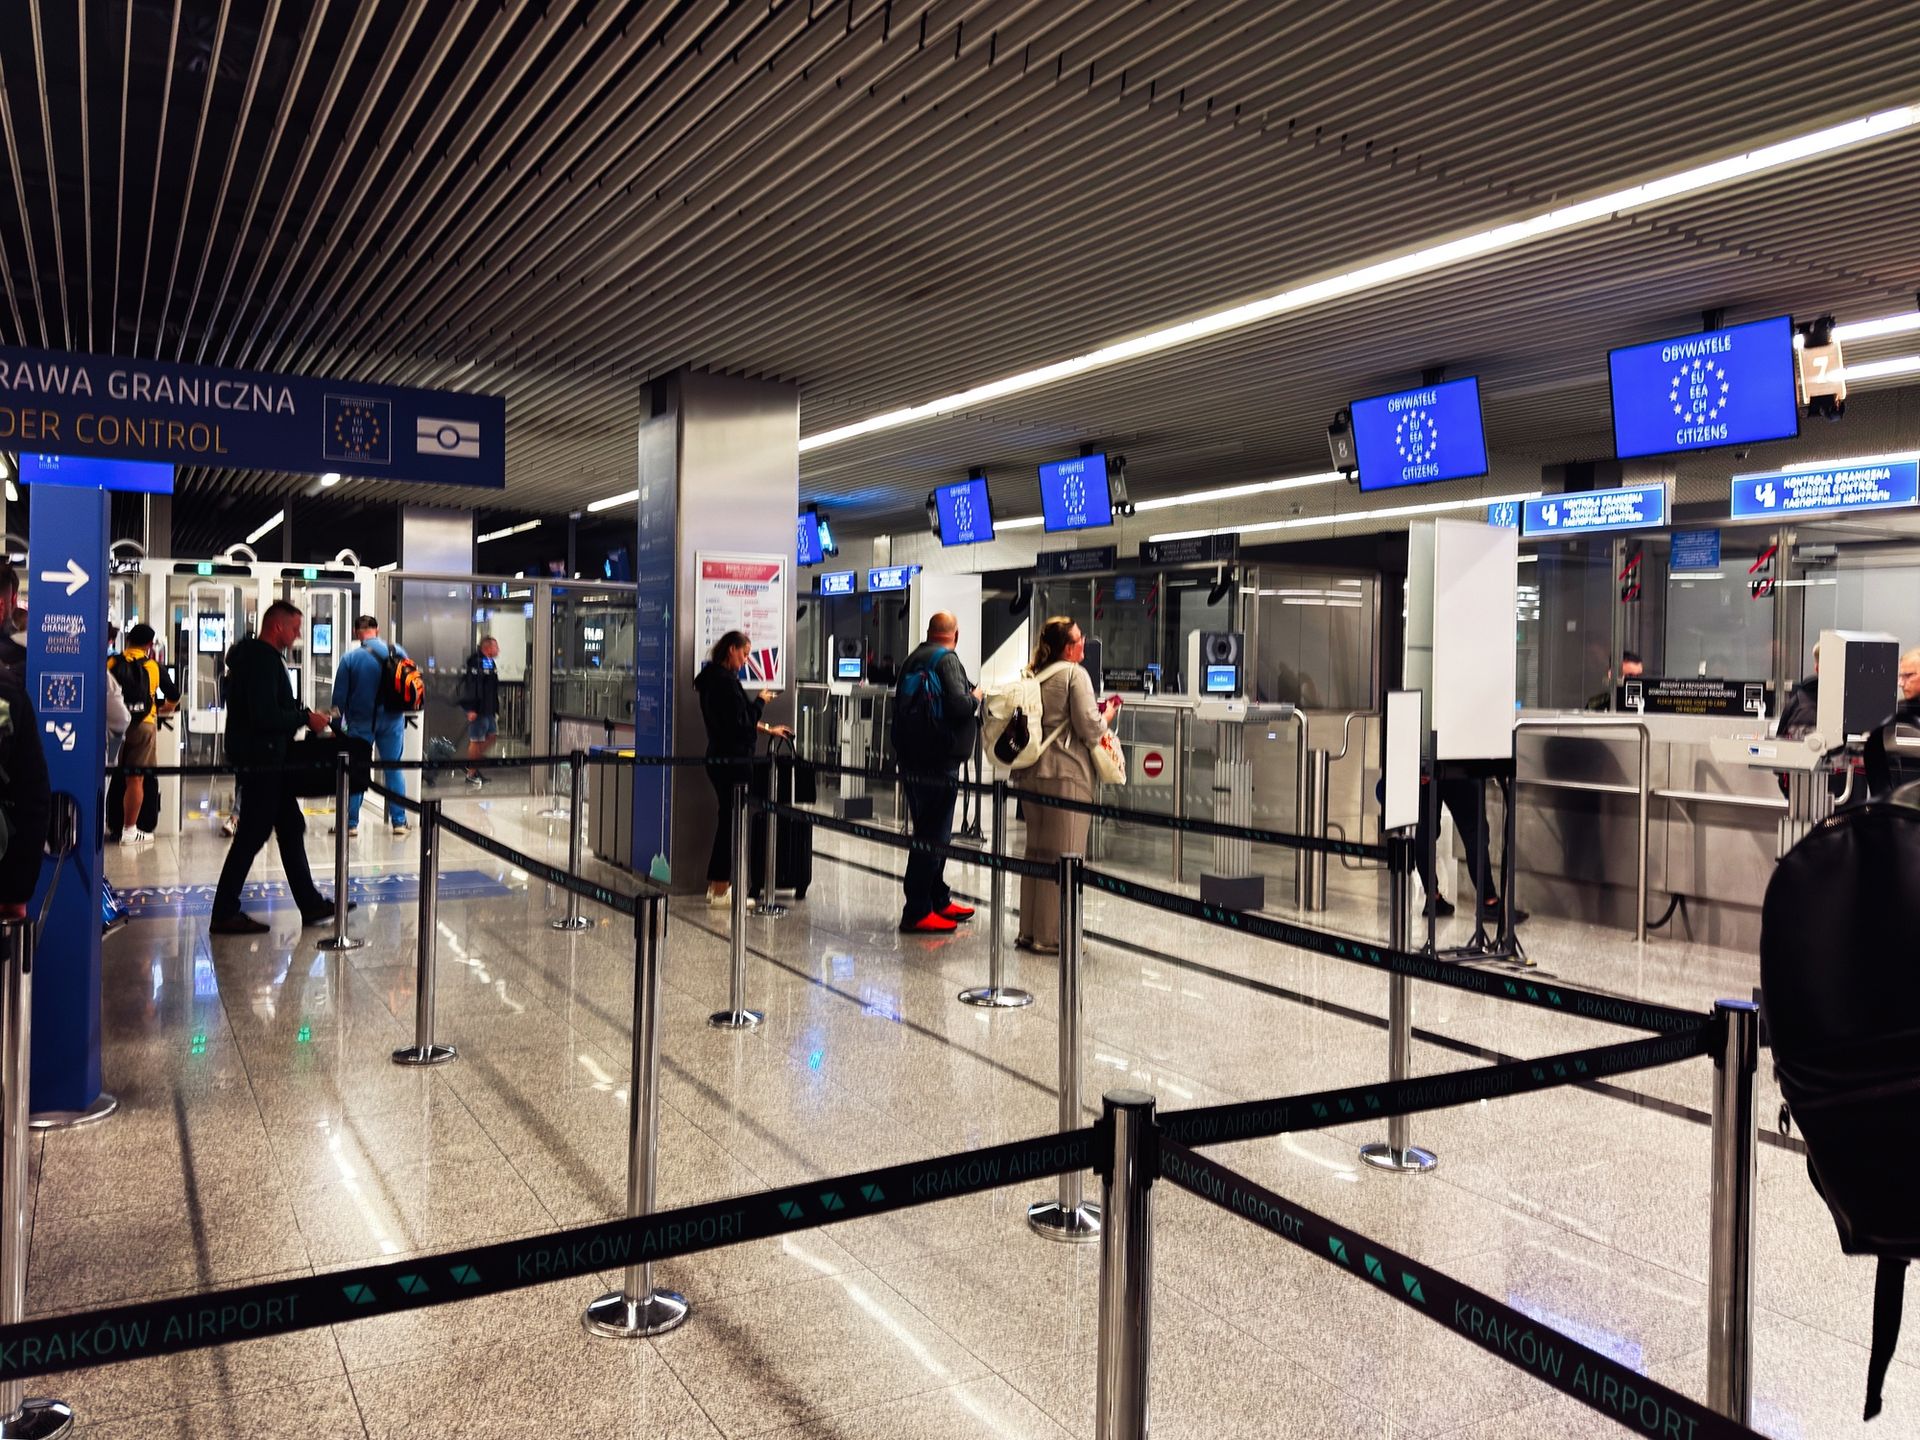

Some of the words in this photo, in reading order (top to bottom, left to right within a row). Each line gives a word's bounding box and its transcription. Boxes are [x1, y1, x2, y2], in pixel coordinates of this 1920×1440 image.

[1662, 334, 1731, 362] OBYWATELE
[1691, 370, 1704, 384] EU
[108, 370, 296, 416] GRANICZNA
[1388, 390, 1437, 412] OBYWATELE
[1690, 384, 1708, 399] EEA
[1692, 399, 1706, 414] CH
[76, 412, 228, 454] CONTROL
[1409, 430, 1423, 443] EEA
[1410, 418, 1420, 431] EU
[1676, 424, 1728, 444] CITIZENS
[1412, 443, 1423, 455] CH
[1402, 462, 1439, 480] CITIZENS
[1440, 966, 1488, 991] AIRPORT
[1224, 1106, 1291, 1136] AIRPORT
[912, 1158, 1000, 1198] KRAKÓW
[1008, 1141, 1090, 1176] AIRPORT
[1161, 1149, 1227, 1201] KRAKÓW
[1232, 1188, 1304, 1241] AIRPORT
[515, 1231, 632, 1279] KRAKÓW
[642, 1210, 748, 1252] AIRPORT
[0, 1319, 150, 1369] KRAKÓW
[163, 1294, 299, 1344] AIRPORT
[1455, 1298, 1562, 1379] KRAKÓW
[1573, 1362, 1700, 1440] AIRPORT
